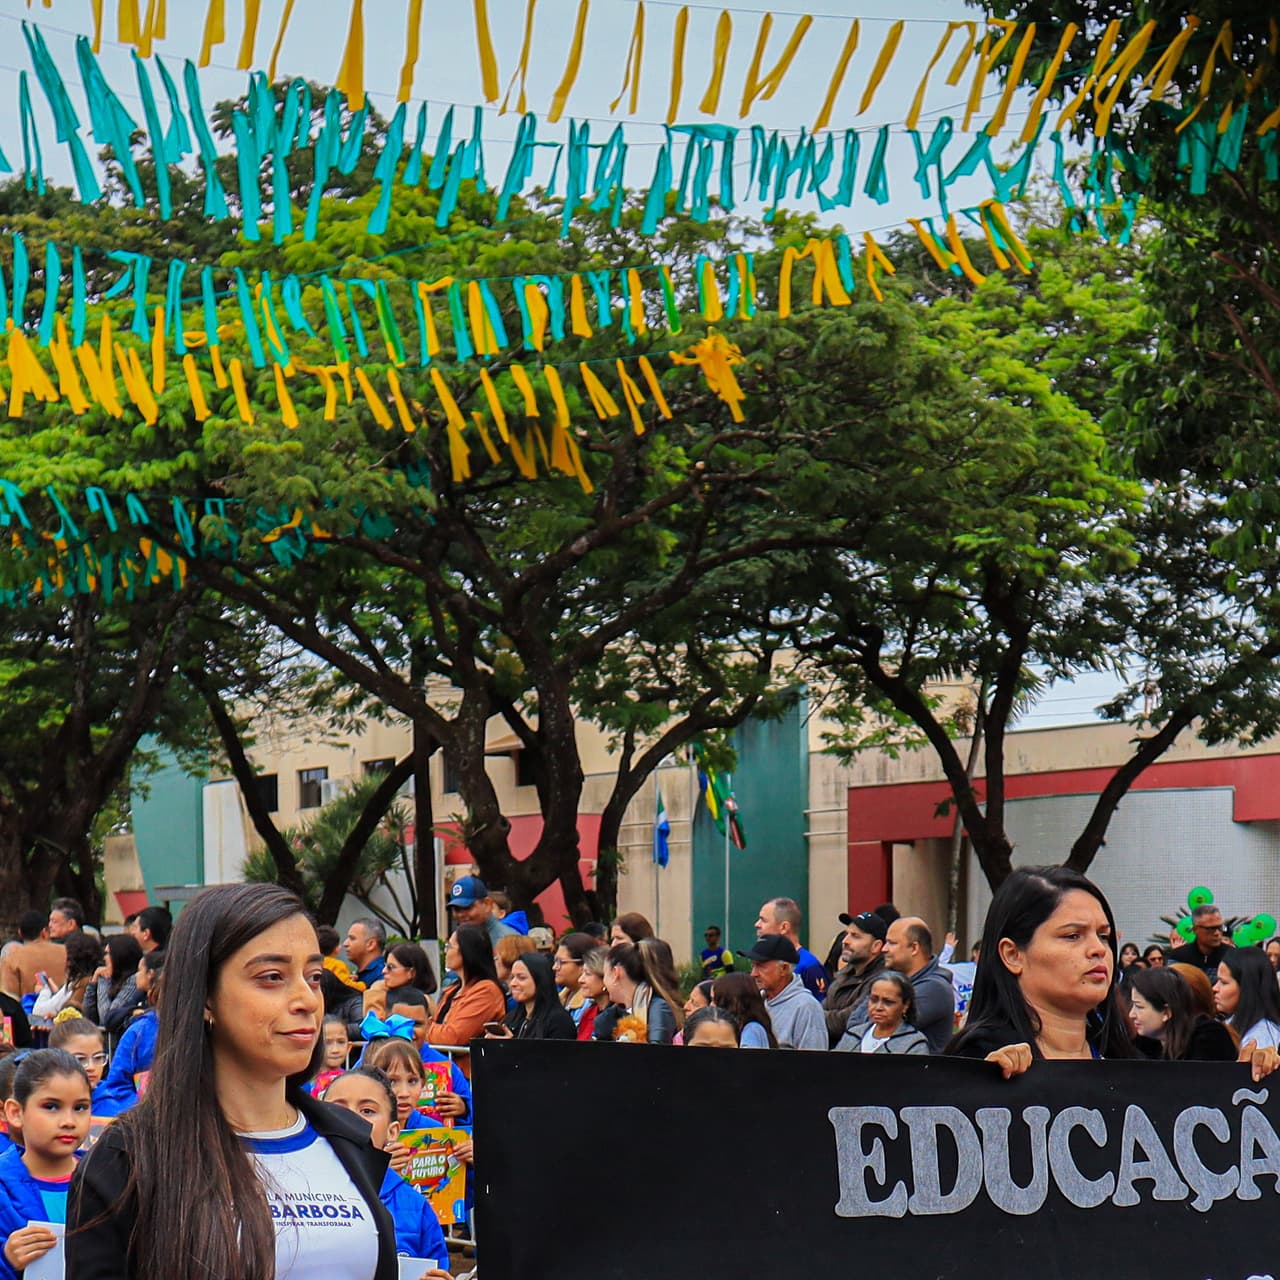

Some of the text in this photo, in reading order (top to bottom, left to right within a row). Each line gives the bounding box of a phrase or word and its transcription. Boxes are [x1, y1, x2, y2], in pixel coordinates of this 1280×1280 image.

[412, 1154, 446, 1168] PARA O
[411, 1166, 445, 1179] FUTURO
[269, 1203, 365, 1221] BARBOSA
